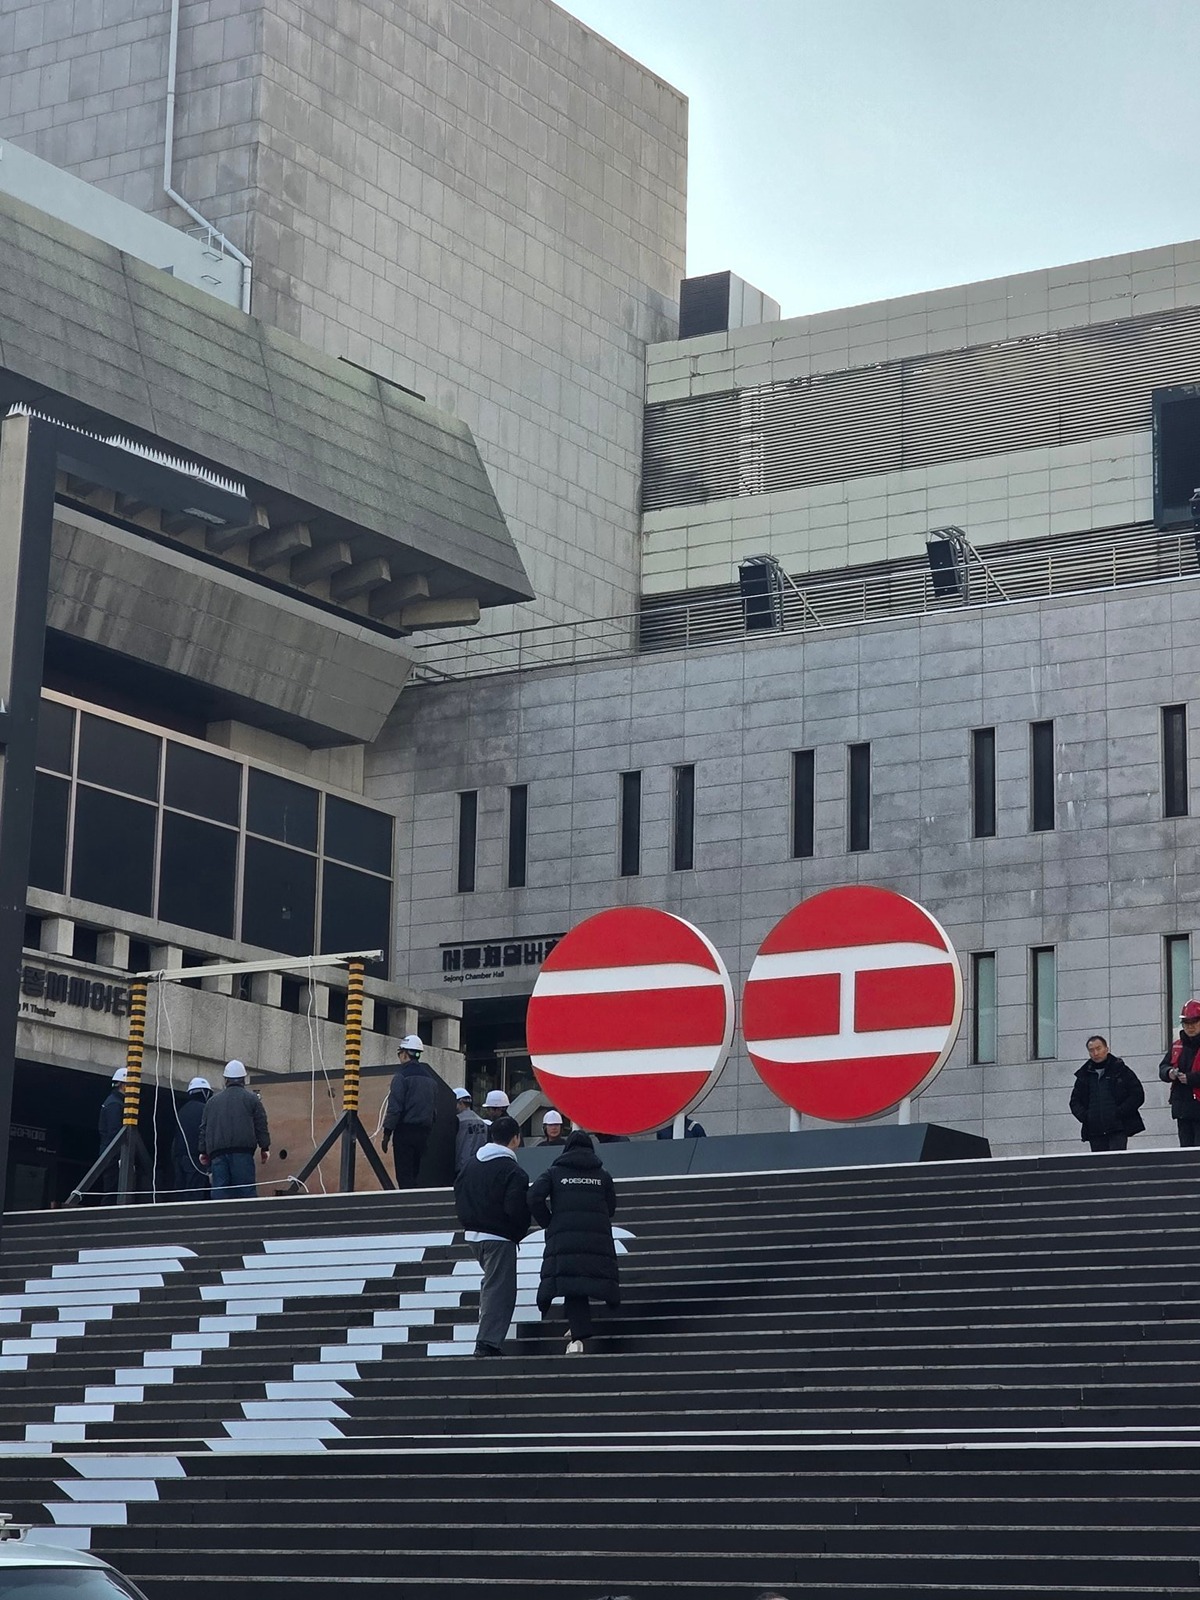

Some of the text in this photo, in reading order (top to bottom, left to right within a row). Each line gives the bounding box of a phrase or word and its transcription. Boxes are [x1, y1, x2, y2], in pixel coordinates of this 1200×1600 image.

[443, 970, 505, 983] Sejong Chamber Hall
[568, 1178, 602, 1186] DESCENTE
